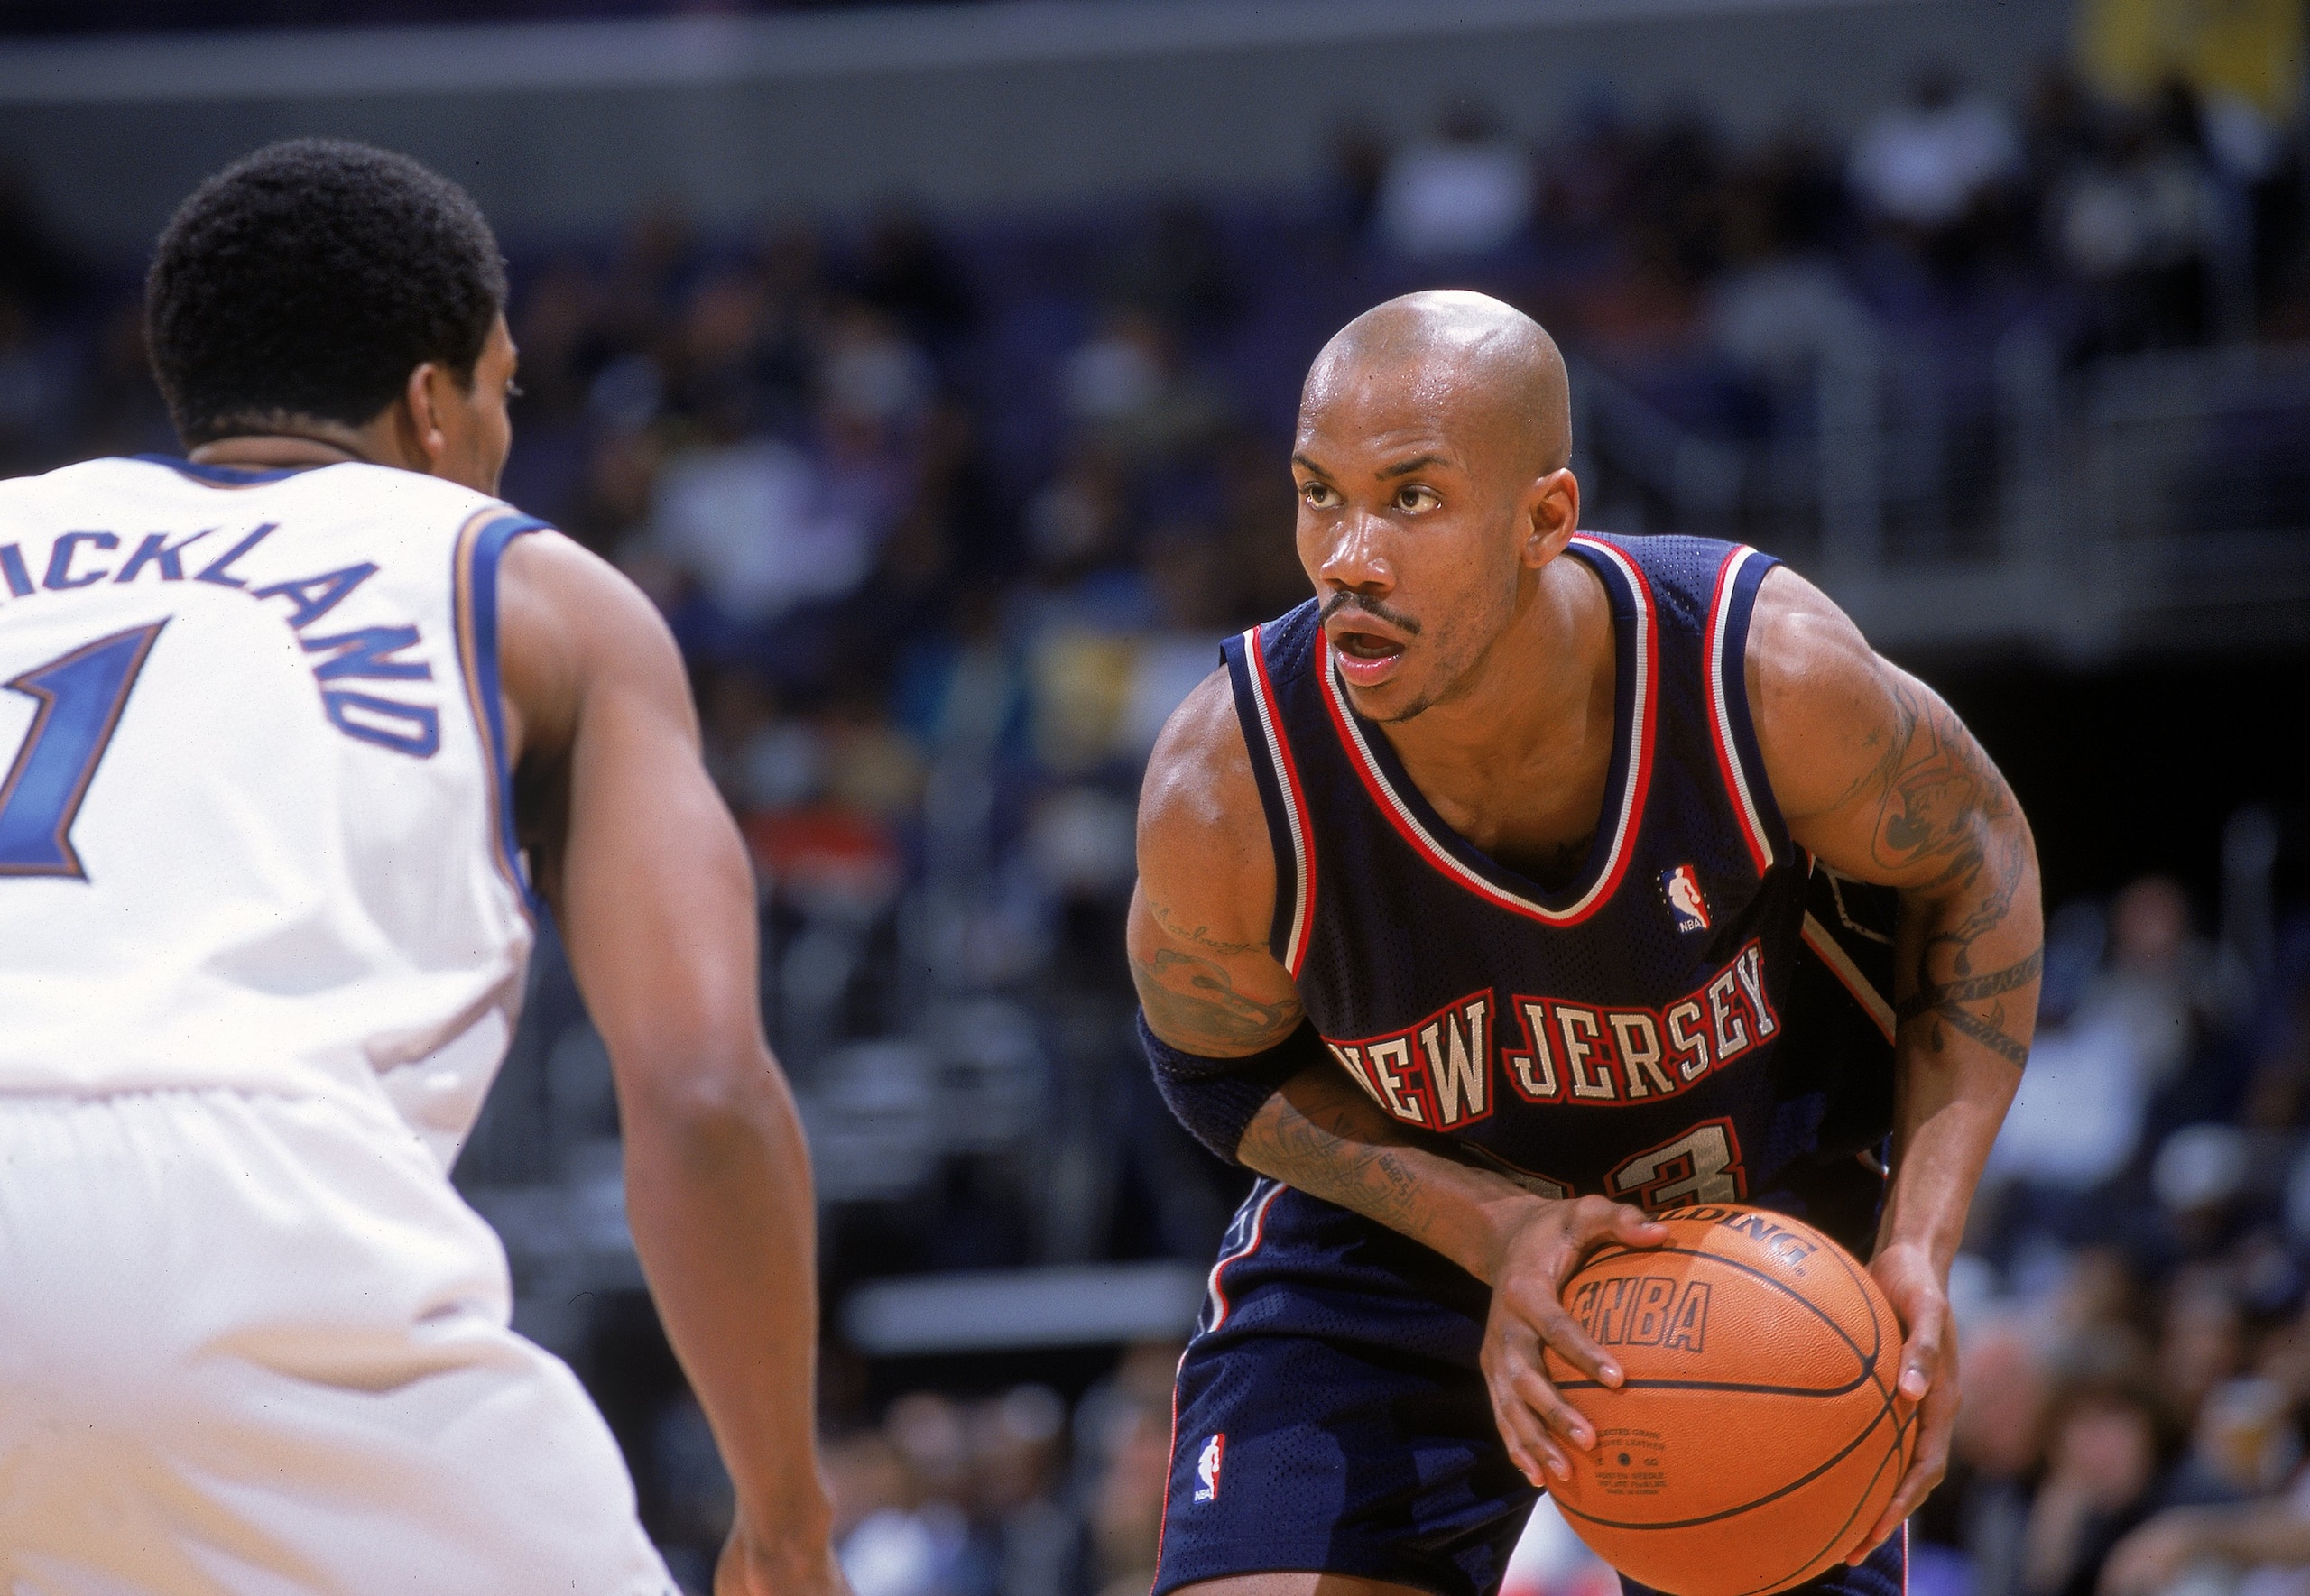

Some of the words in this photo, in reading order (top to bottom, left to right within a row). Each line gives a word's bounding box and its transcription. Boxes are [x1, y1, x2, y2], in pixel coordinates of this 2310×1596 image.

[0, 523, 440, 759] ICKLAND
[1679, 918, 1703, 933] NBA
[1502, 937, 1781, 1106] JERSEY
[1650, 1207, 1817, 1268] LDING
[1592, 1277, 1711, 1353] NBA
[1194, 1488, 1212, 1501] NBA
